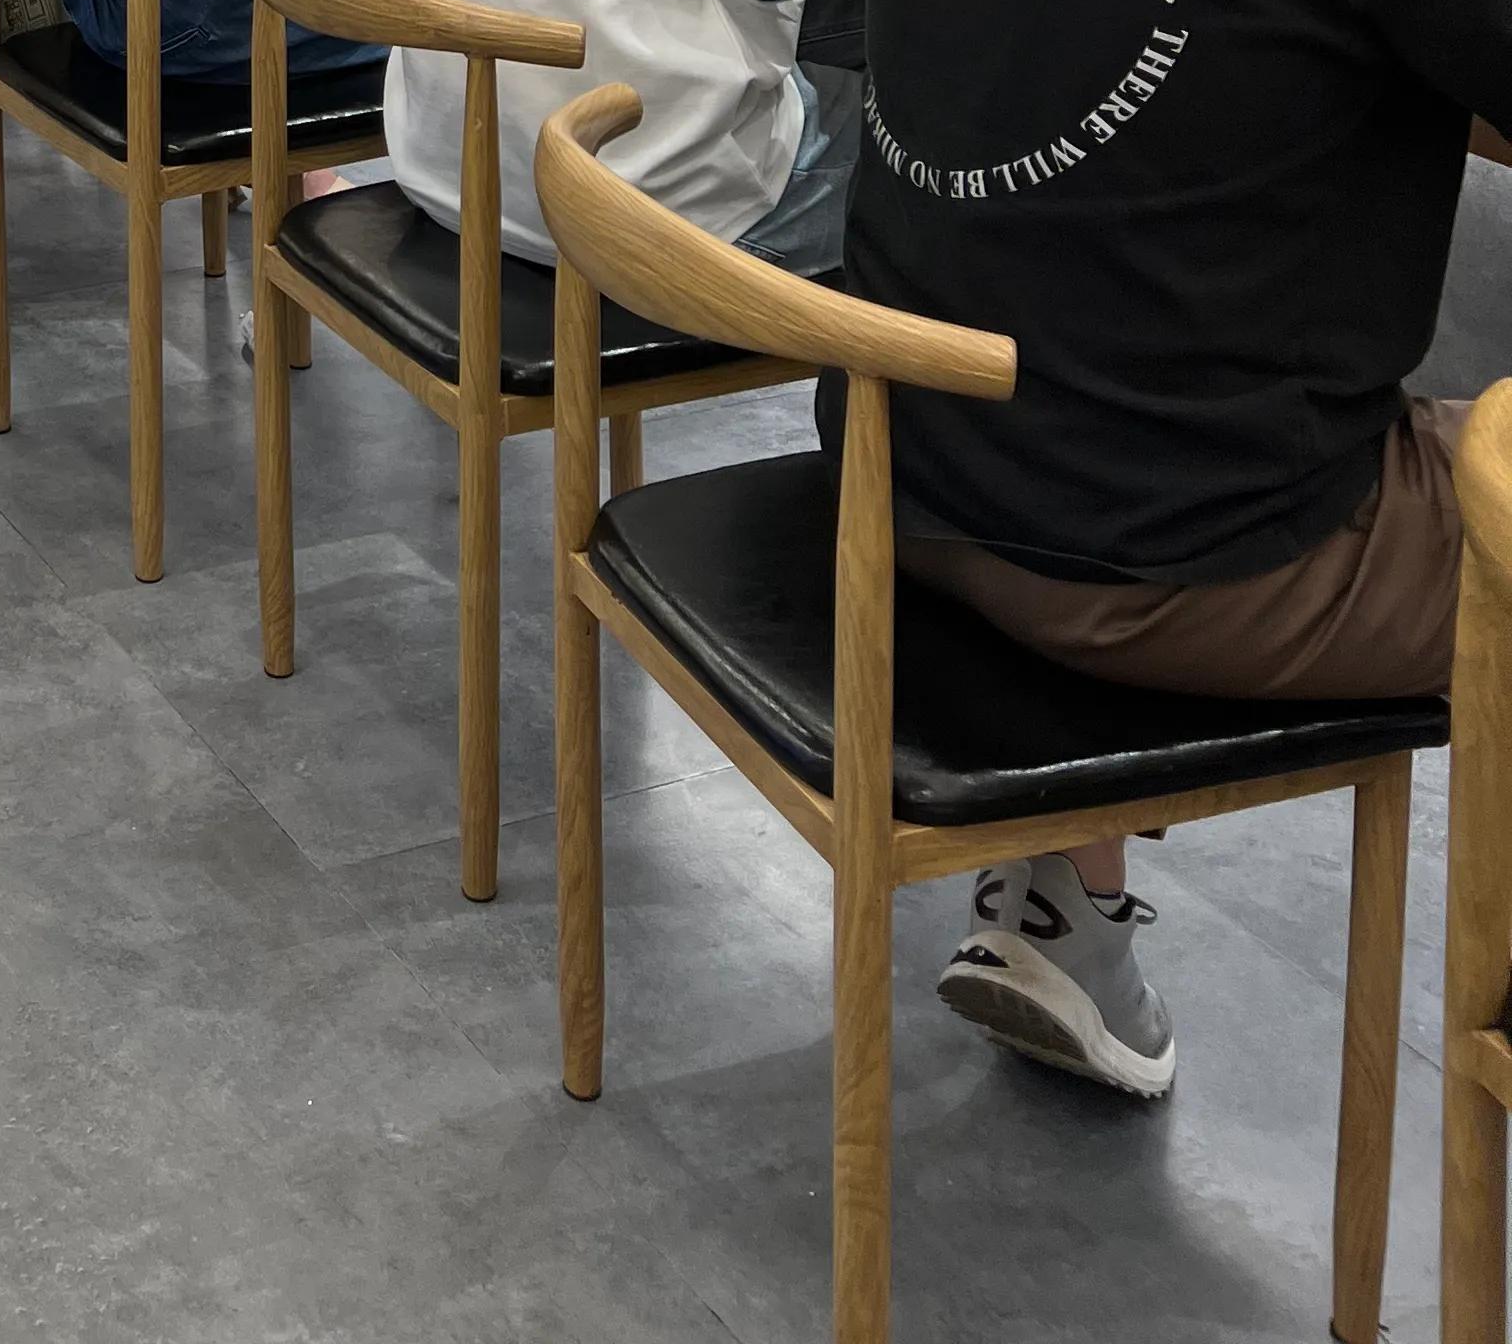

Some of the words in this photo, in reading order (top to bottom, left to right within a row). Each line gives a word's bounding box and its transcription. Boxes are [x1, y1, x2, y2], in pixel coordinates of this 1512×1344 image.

[1079, 26, 1189, 145] THERE
[909, 160, 942, 198] NO
[948, 169, 989, 199] BE
[991, 136, 1087, 193] WILL
